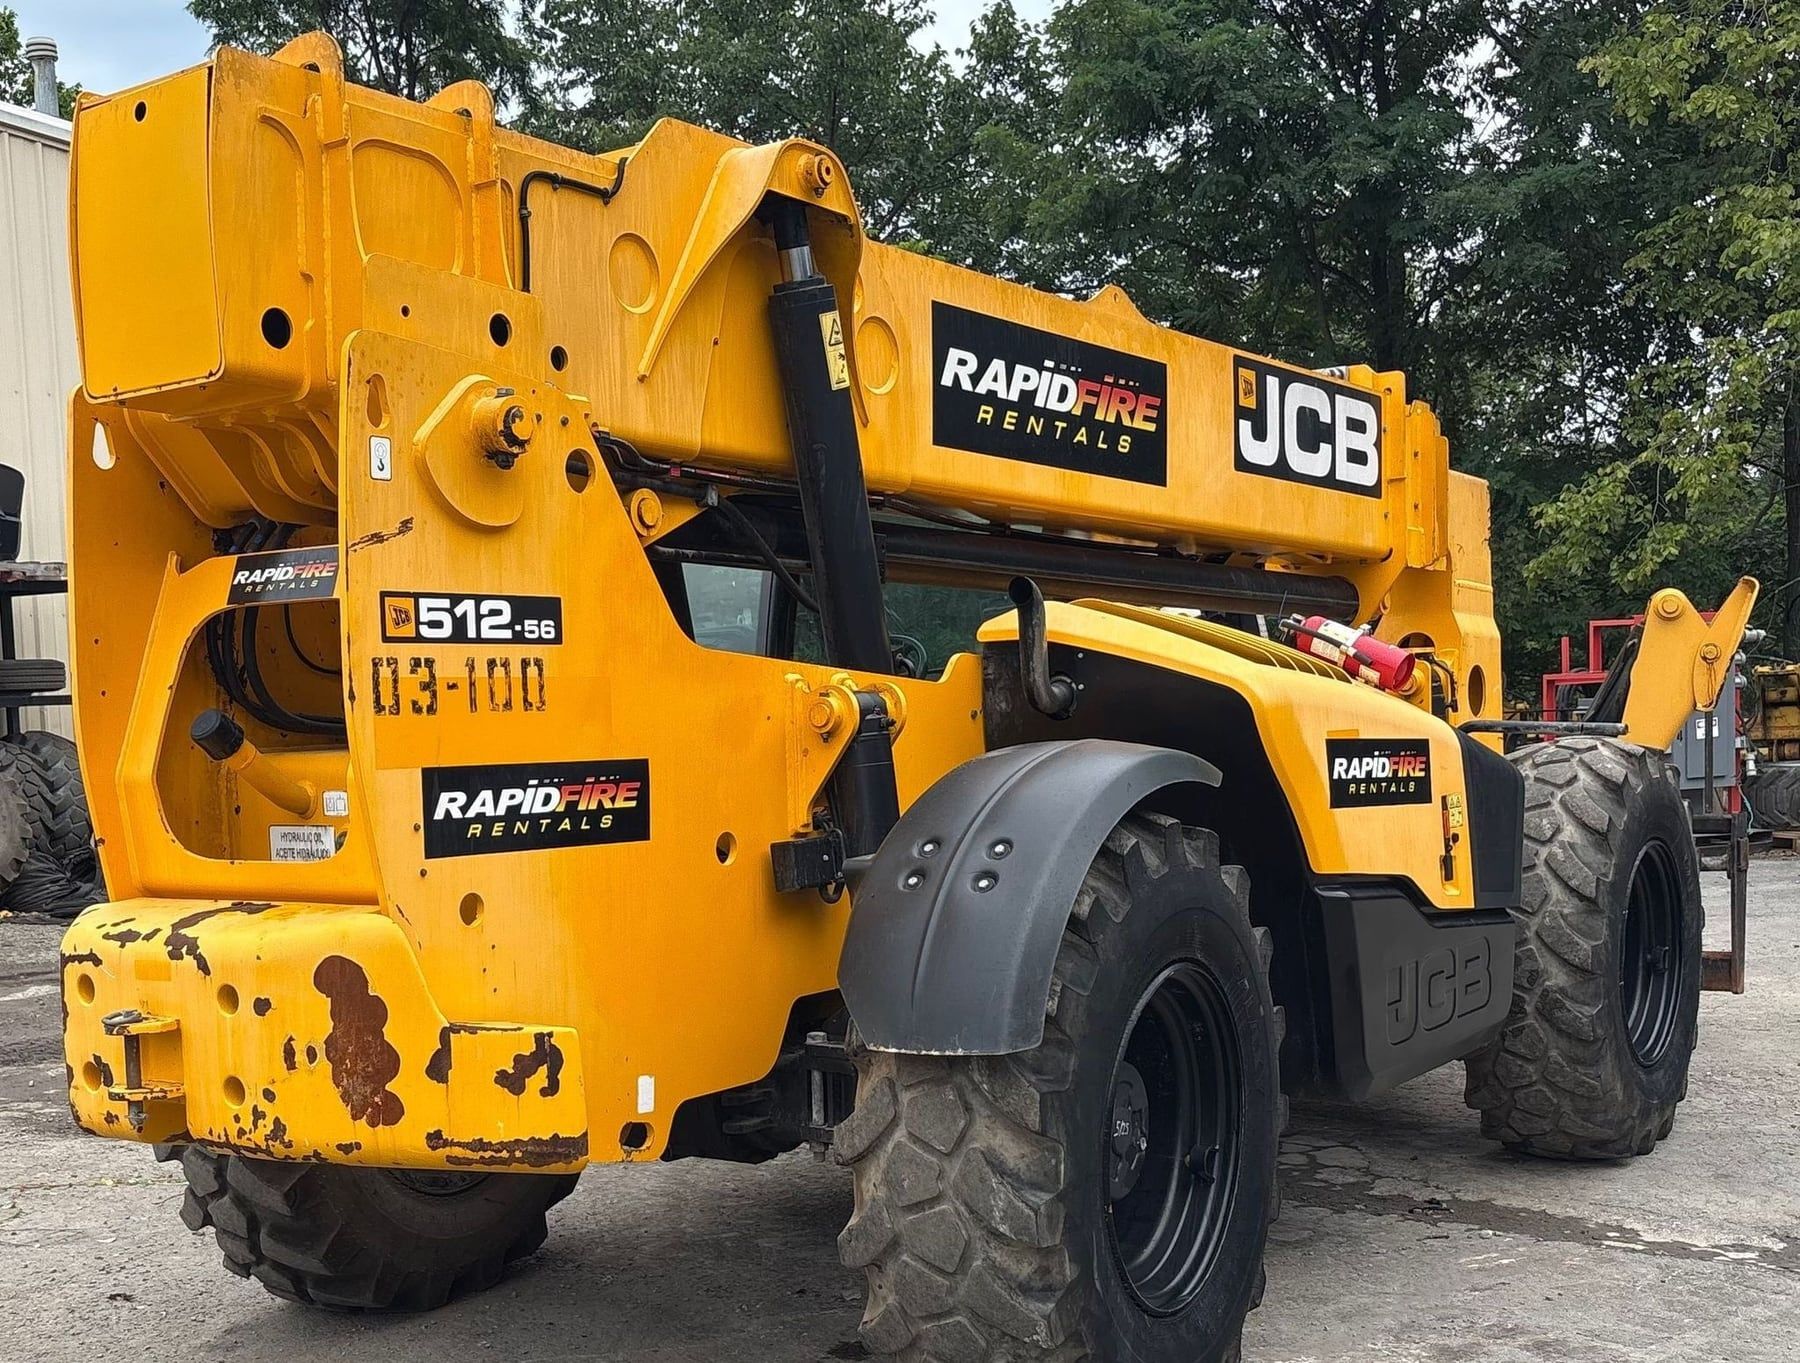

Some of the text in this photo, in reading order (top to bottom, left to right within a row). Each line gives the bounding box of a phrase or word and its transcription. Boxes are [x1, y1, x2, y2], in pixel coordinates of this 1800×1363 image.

[940, 347, 1162, 432] RAPIDFIRE
[976, 405, 1132, 454] RENTALS
[1238, 374, 1379, 487] JCB
[244, 579, 319, 593] RENTALS
[392, 606, 411, 628] JCB
[371, 657, 547, 716] 03-100
[433, 779, 641, 821] RAPIDFIRE
[1348, 781, 1416, 795] RENTALS
[280, 831, 312, 843] HYDRAULIC
[467, 814, 614, 839] RENTALS
[1386, 936, 1492, 1045] JCB
